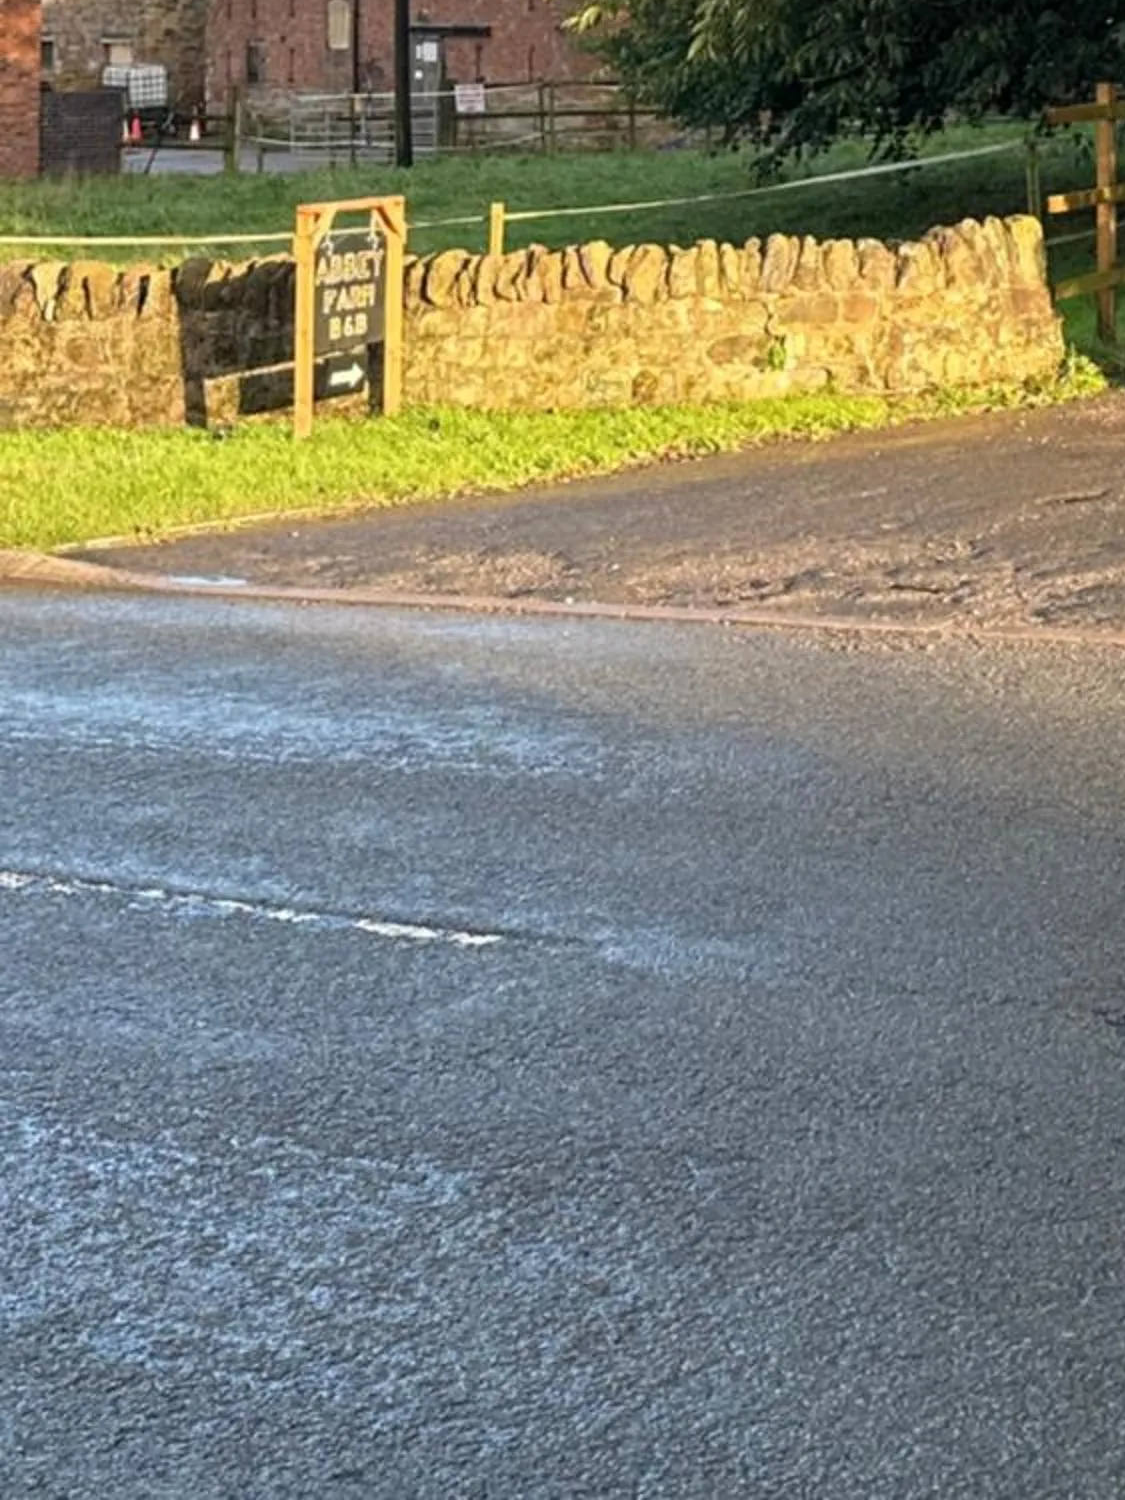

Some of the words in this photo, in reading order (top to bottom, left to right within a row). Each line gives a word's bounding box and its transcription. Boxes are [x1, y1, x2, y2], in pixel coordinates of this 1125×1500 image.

[315, 249, 384, 286] ABBEY
[322, 284, 376, 314] FARM
[329, 313, 367, 340] B&B
